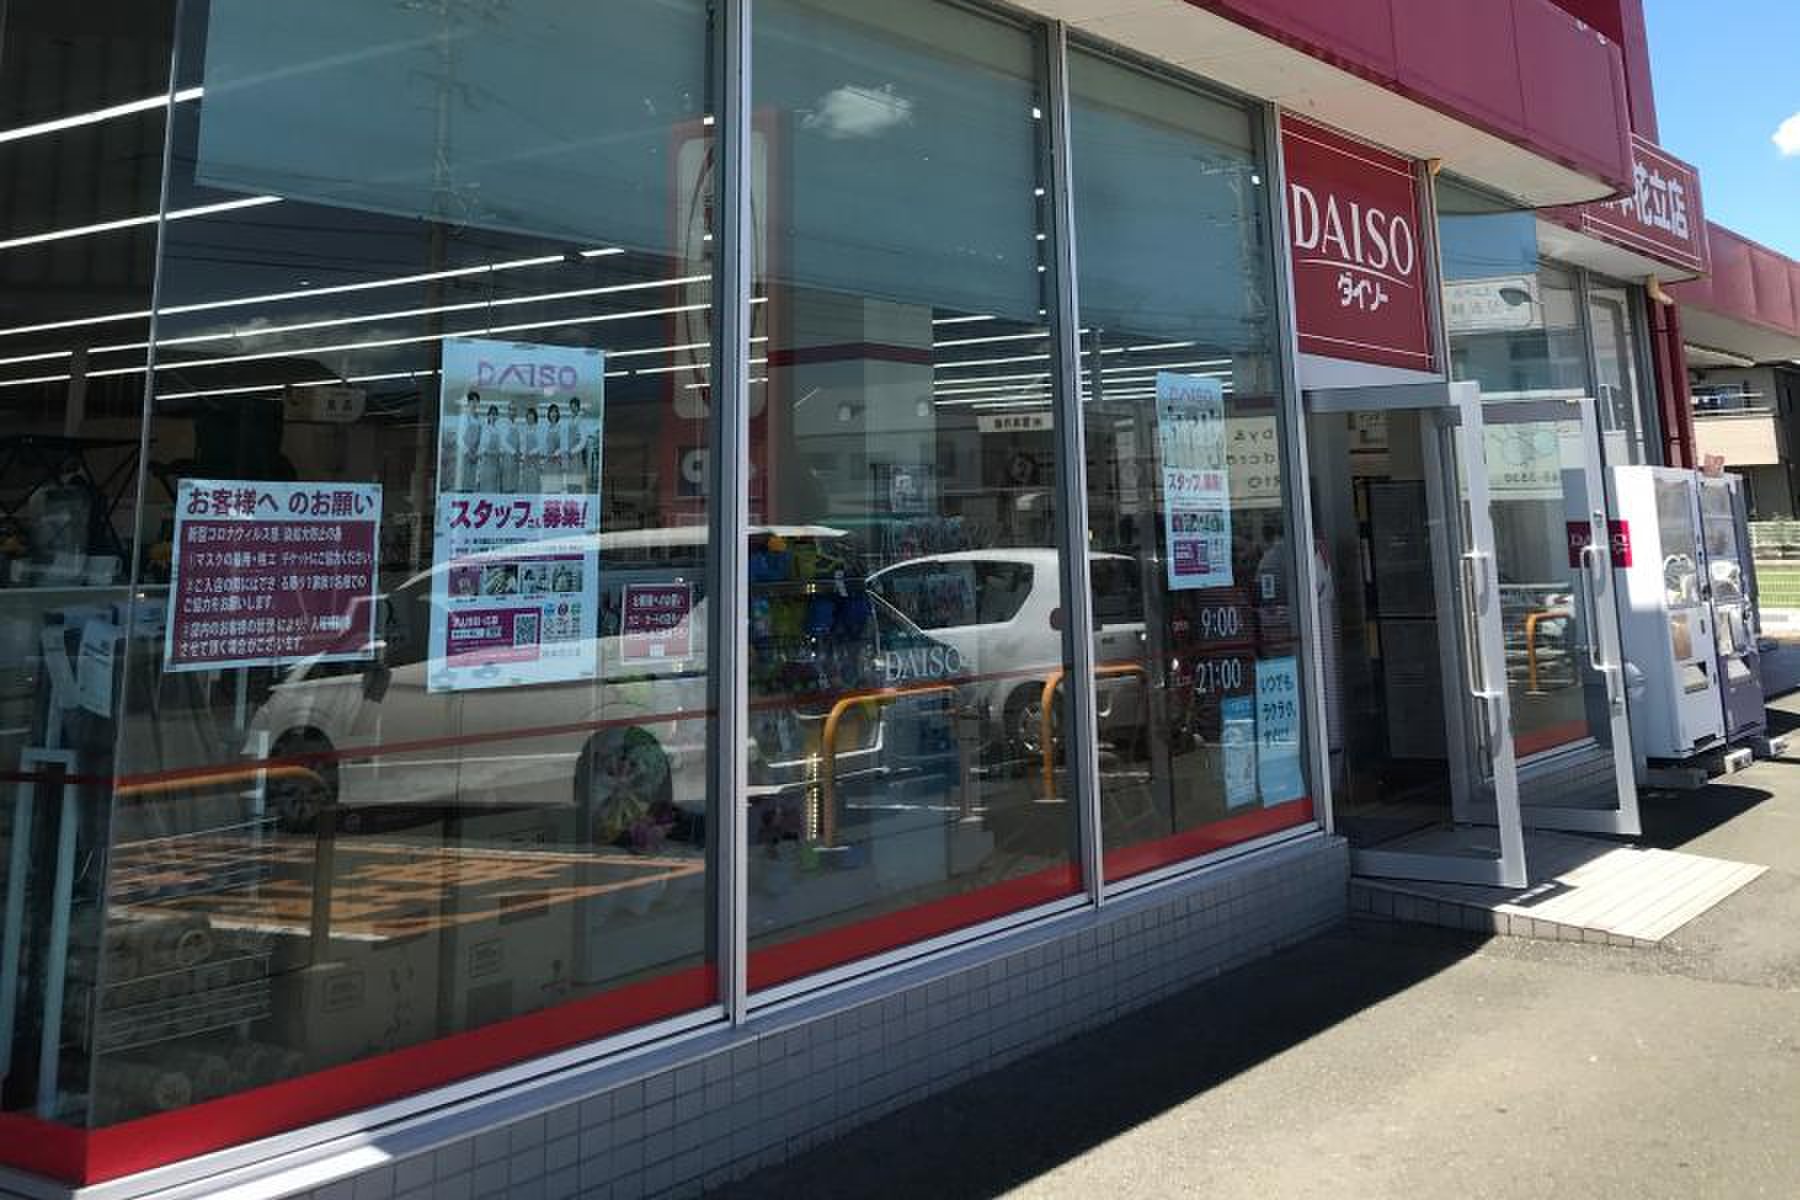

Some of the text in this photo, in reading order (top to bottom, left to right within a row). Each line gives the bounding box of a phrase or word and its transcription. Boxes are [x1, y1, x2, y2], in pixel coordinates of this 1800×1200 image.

[1600, 162, 1689, 240] 花立店
[1291, 184, 1414, 274] DAISO
[1337, 275, 1388, 312] ダイソー
[477, 360, 577, 391] DAISO
[187, 487, 374, 517] お客様へのお願い
[885, 648, 962, 681] DAISO
[1195, 658, 1242, 693] 21:00
